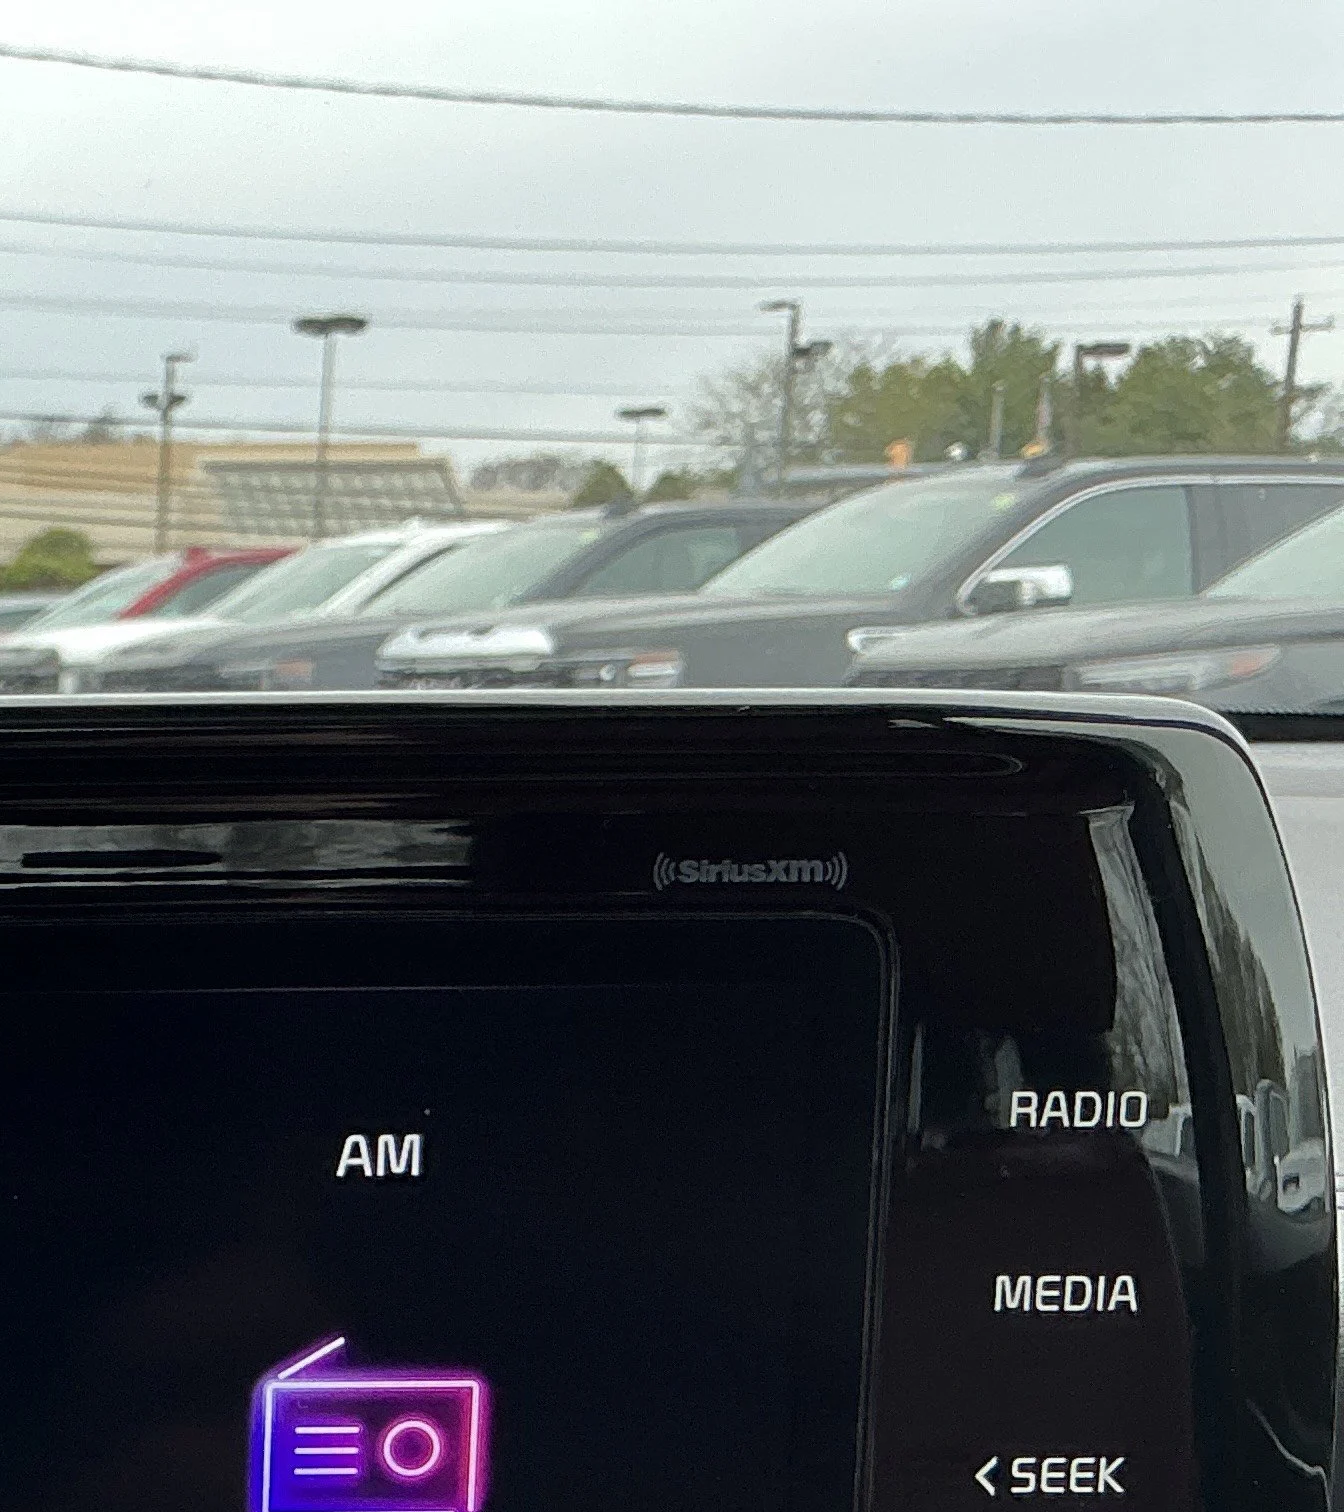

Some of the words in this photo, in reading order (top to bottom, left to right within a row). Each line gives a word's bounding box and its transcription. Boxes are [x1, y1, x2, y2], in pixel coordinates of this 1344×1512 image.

[1010, 1090, 1148, 1128] RADIO
[336, 1133, 421, 1177] AM
[993, 1275, 1138, 1312] MEDIA
